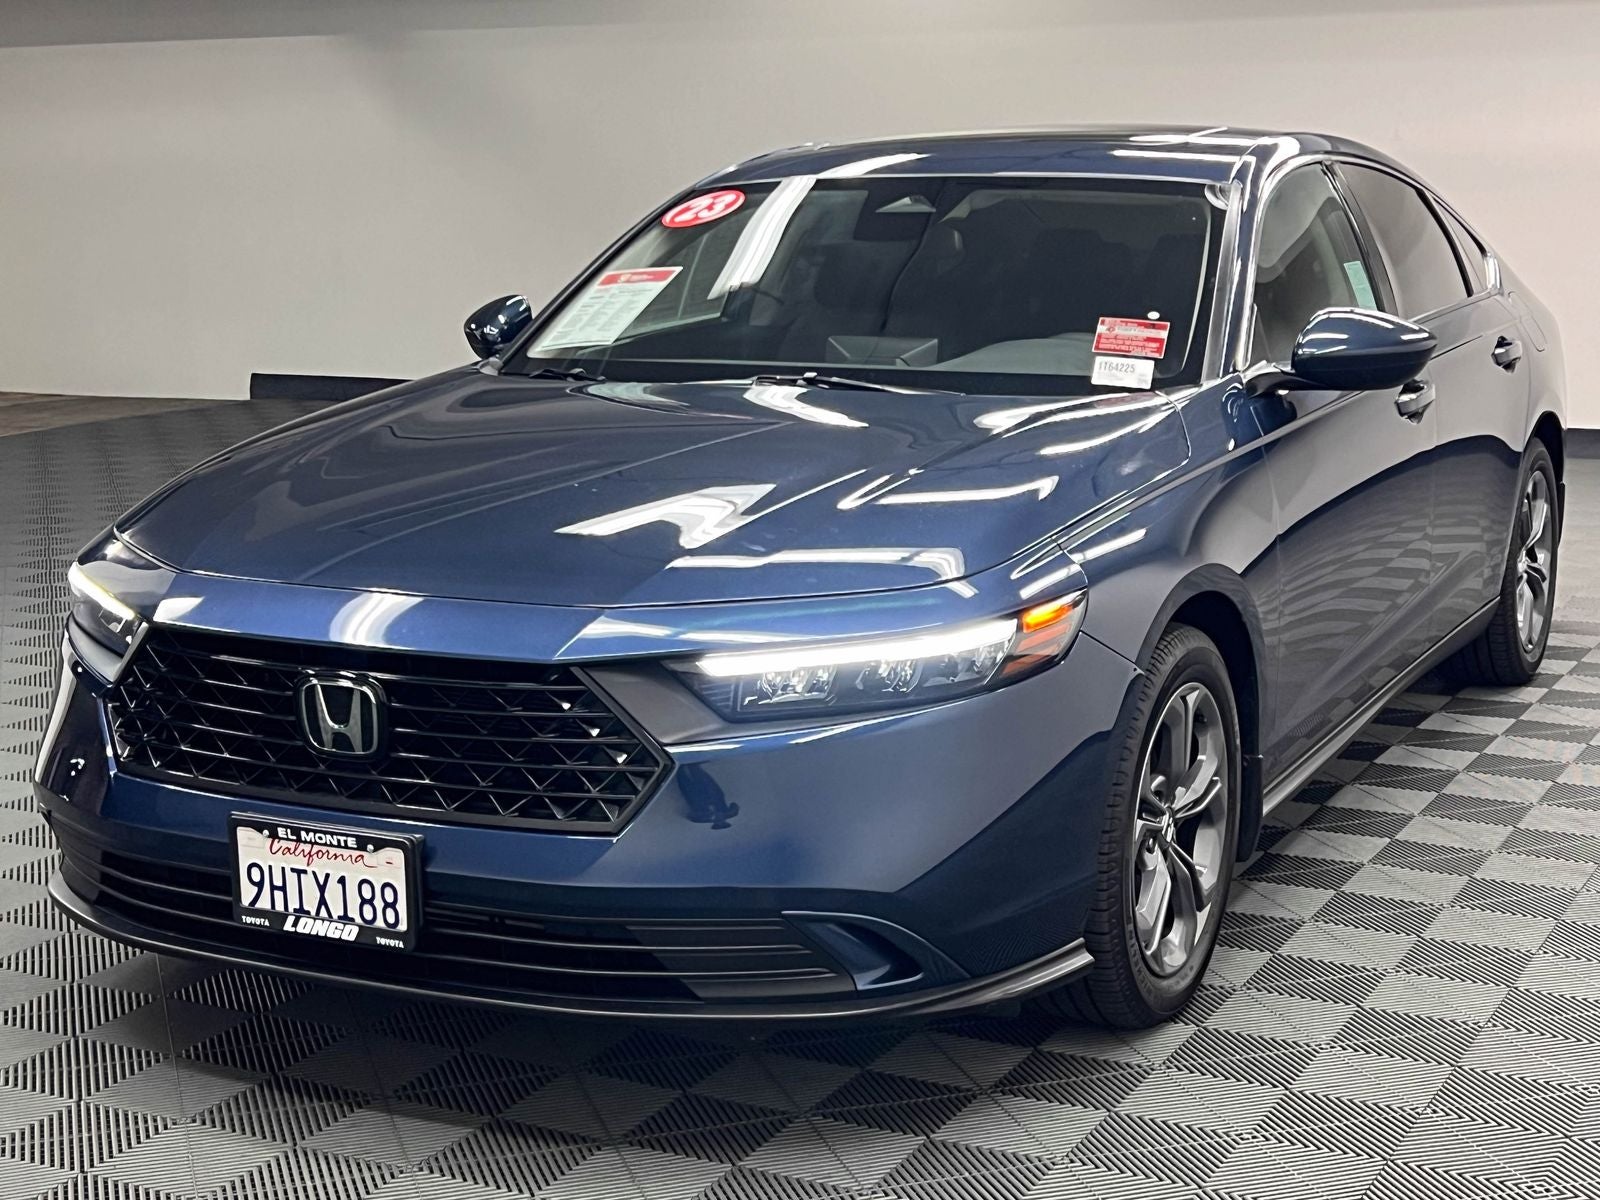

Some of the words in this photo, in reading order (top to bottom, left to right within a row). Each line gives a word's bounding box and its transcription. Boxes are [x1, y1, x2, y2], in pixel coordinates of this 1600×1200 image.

[673, 193, 737, 223] 23
[277, 827, 297, 840] EL
[300, 830, 357, 848] MONTE
[269, 837, 378, 868] California
[246, 861, 400, 930] 9HIX188
[241, 915, 270, 927] TOYOTA
[283, 915, 360, 942] LONGO
[375, 936, 404, 949] TOYOTA
